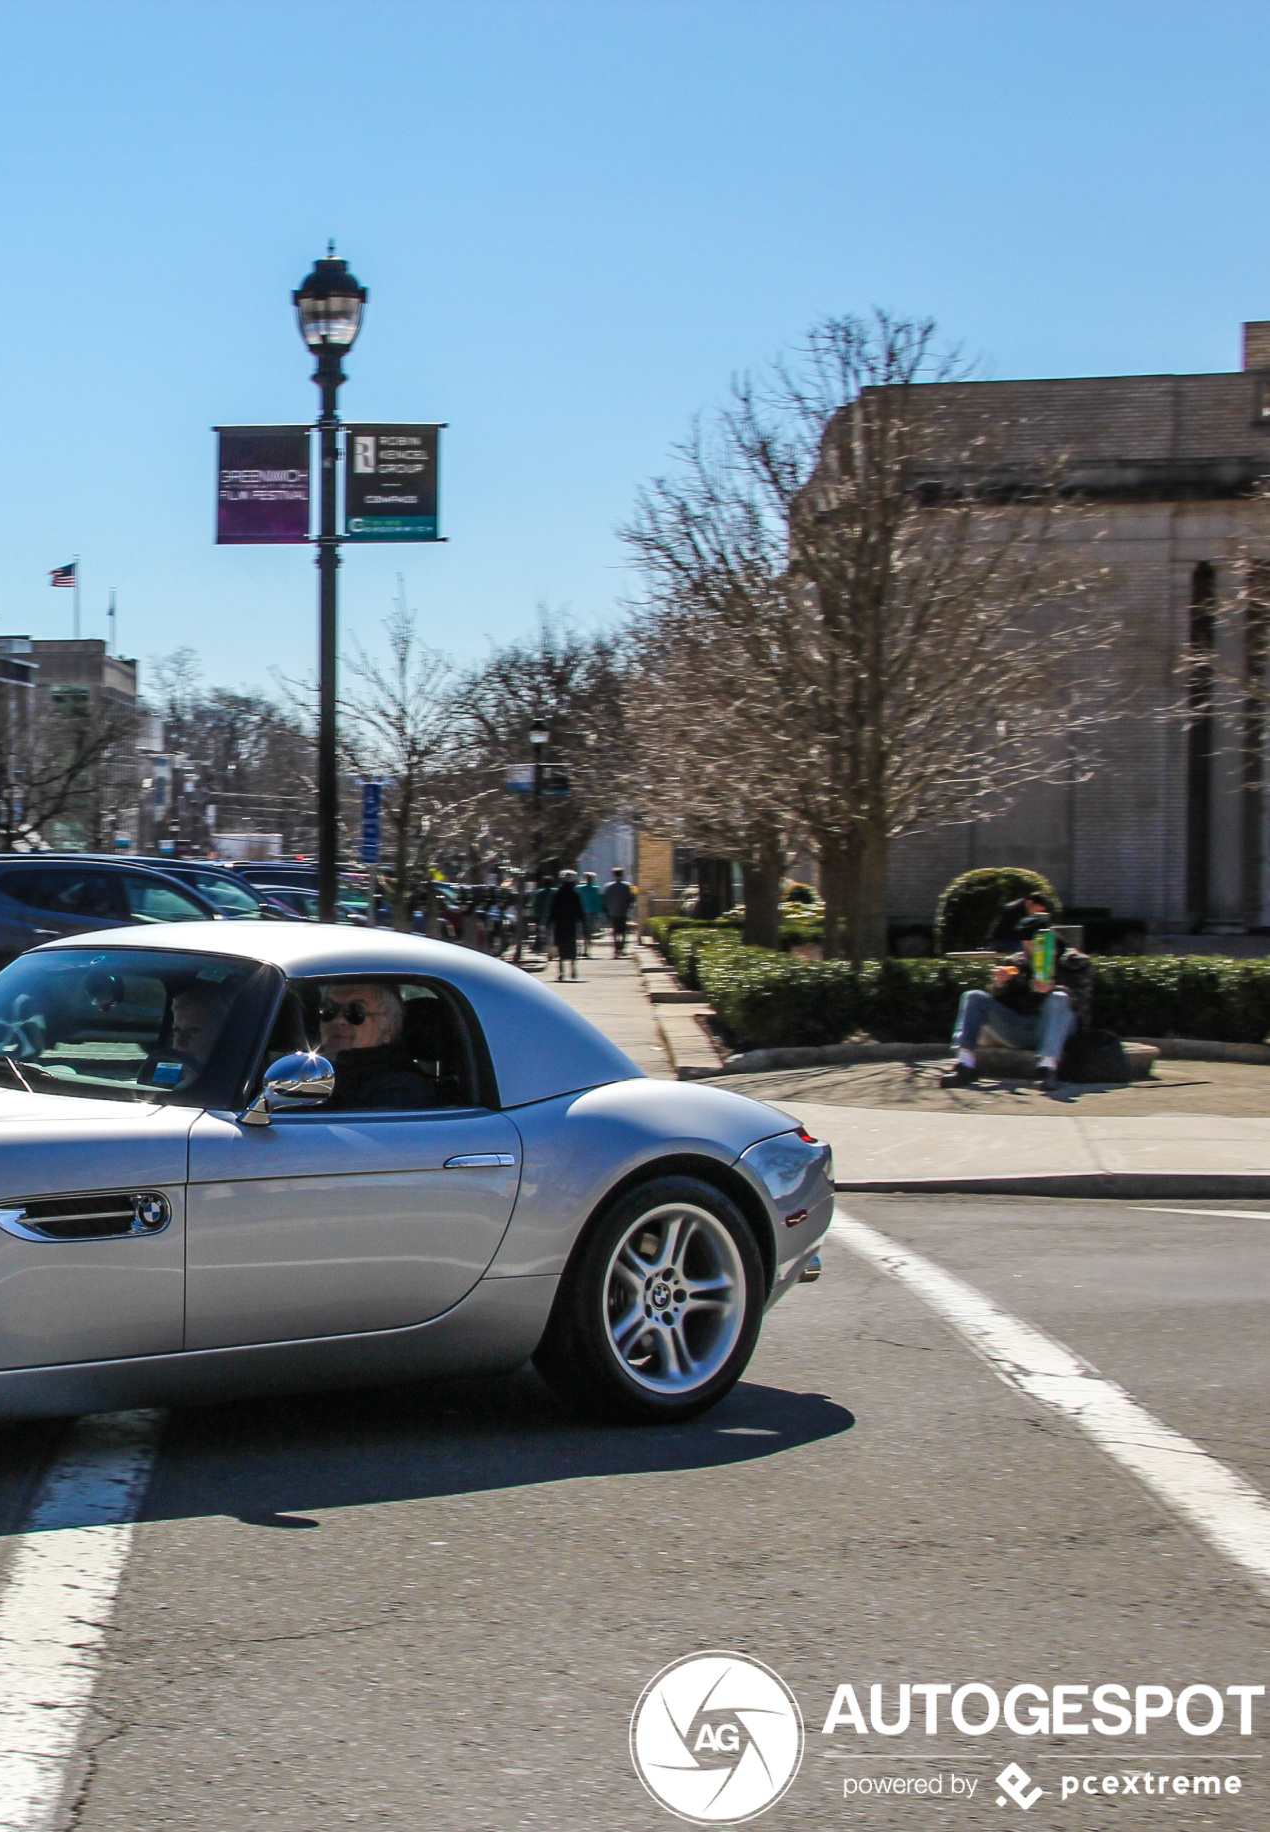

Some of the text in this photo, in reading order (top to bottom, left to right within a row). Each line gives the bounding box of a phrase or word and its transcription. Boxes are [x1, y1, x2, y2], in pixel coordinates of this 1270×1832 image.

[378, 436, 422, 446] ROBIN
[378, 464, 426, 474] GROUP
[220, 469, 309, 483] GREENWICH
[219, 490, 309, 501] FILM FESTIVAL
